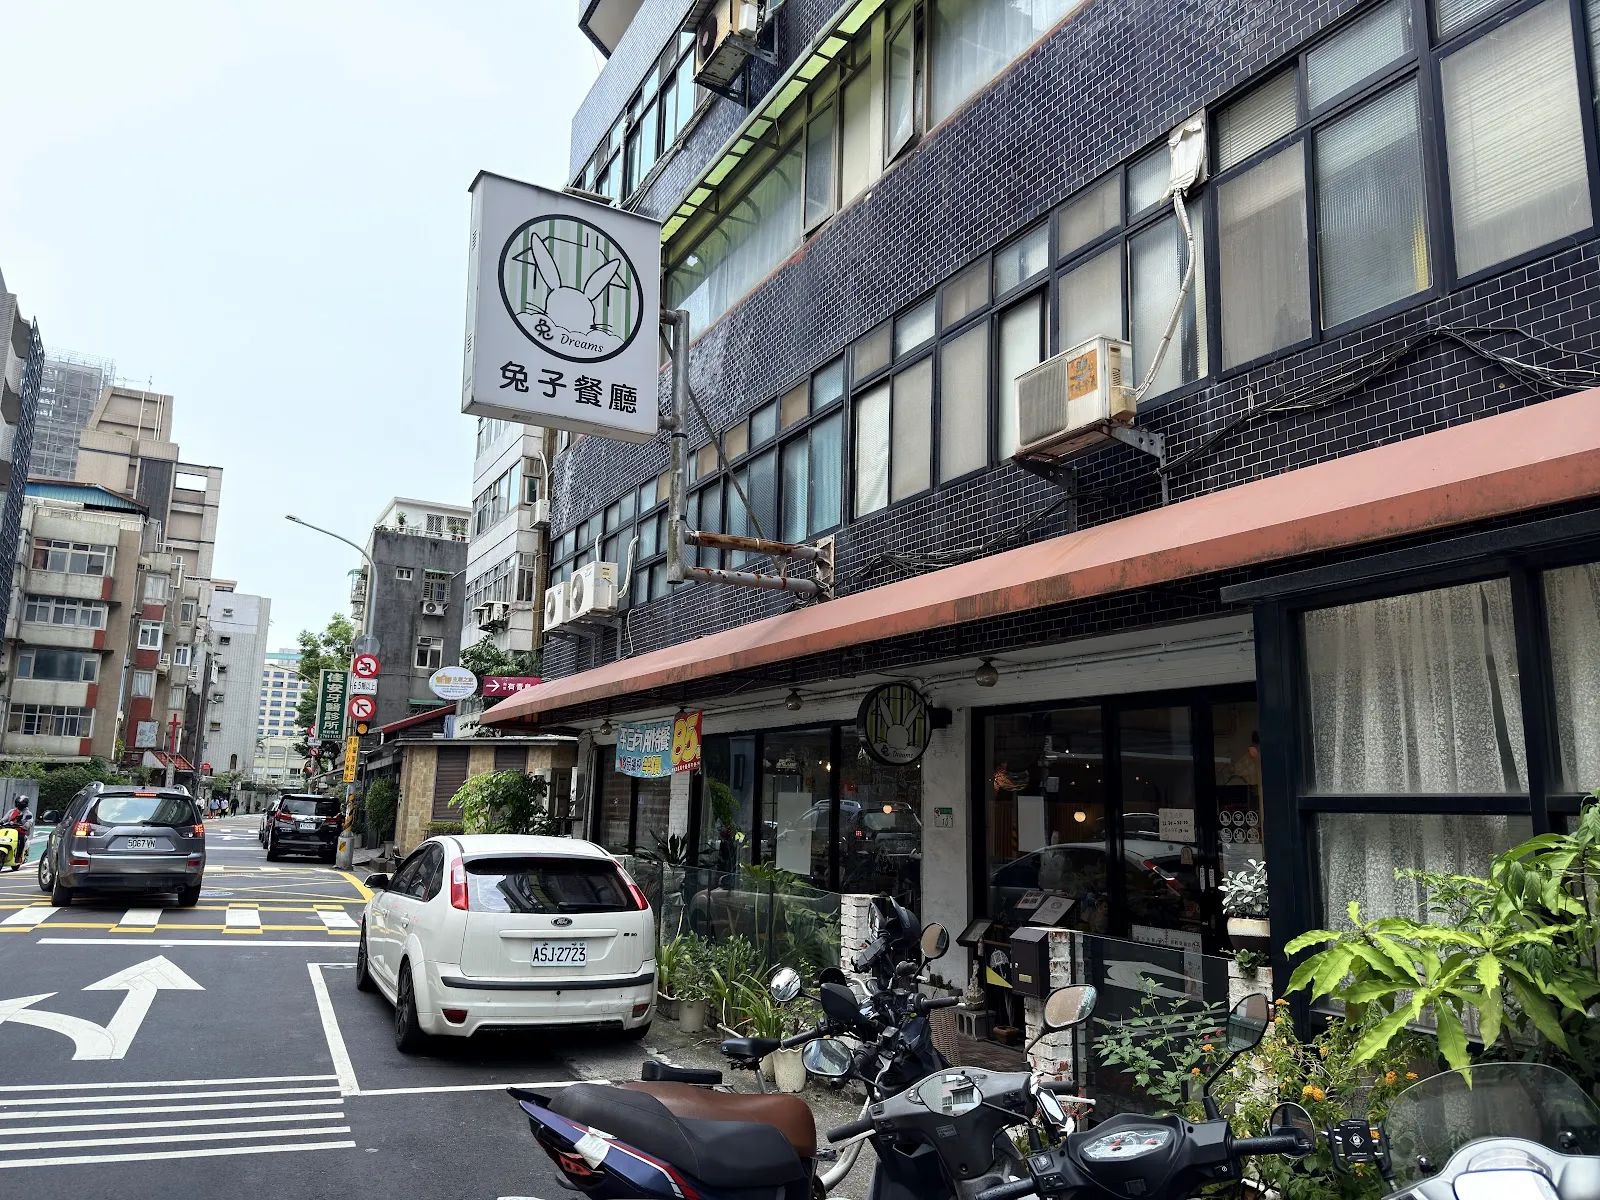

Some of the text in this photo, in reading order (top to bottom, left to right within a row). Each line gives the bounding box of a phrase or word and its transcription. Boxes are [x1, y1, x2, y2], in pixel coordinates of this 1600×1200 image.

[560, 333, 604, 353] Dreams
[499, 360, 637, 414] 兔子餐廳
[323, 672, 344, 730] 佳安牙醫診所
